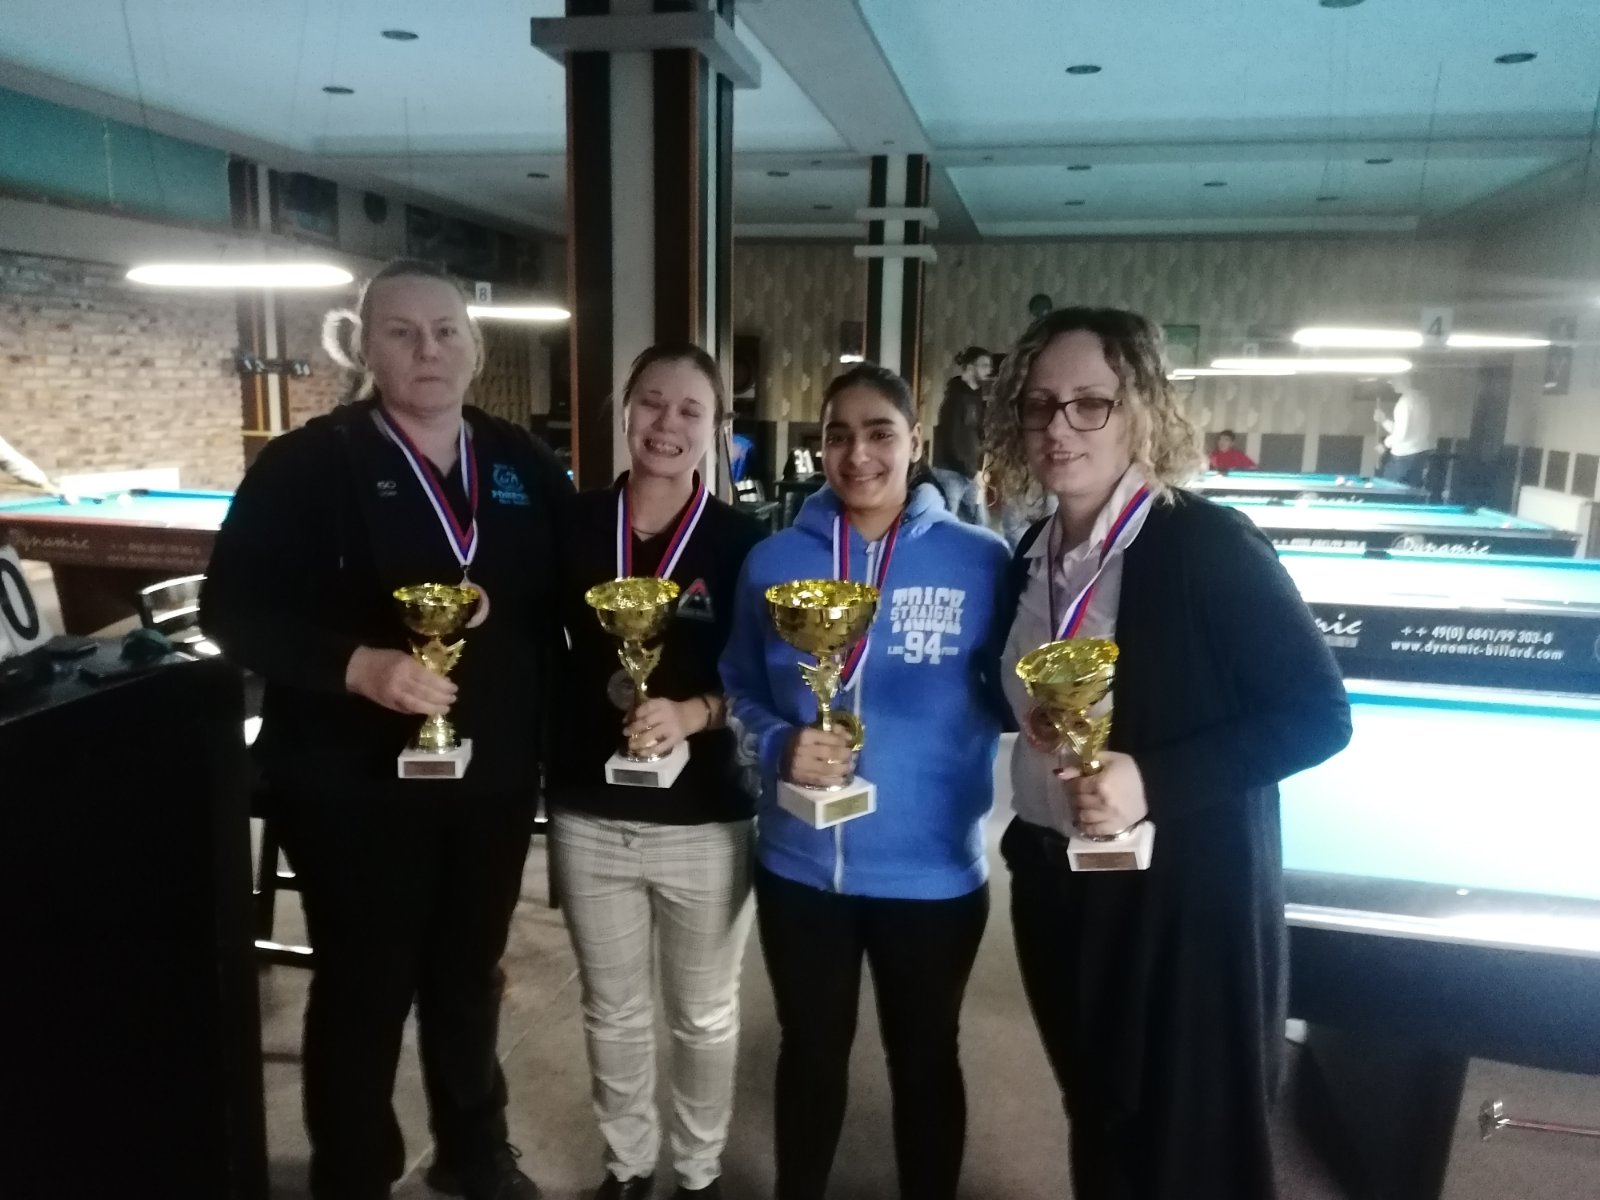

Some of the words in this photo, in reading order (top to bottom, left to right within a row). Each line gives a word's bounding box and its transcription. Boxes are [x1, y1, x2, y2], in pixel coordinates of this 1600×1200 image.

[1427, 315, 1443, 338] 4
[0, 558, 40, 641] 0
[890, 604, 964, 623] STRAIGHT
[903, 631, 942, 665] 94
[1517, 630, 1555, 645] 303-0
[1391, 639, 1565, 661] www.dynamic-billard.com
